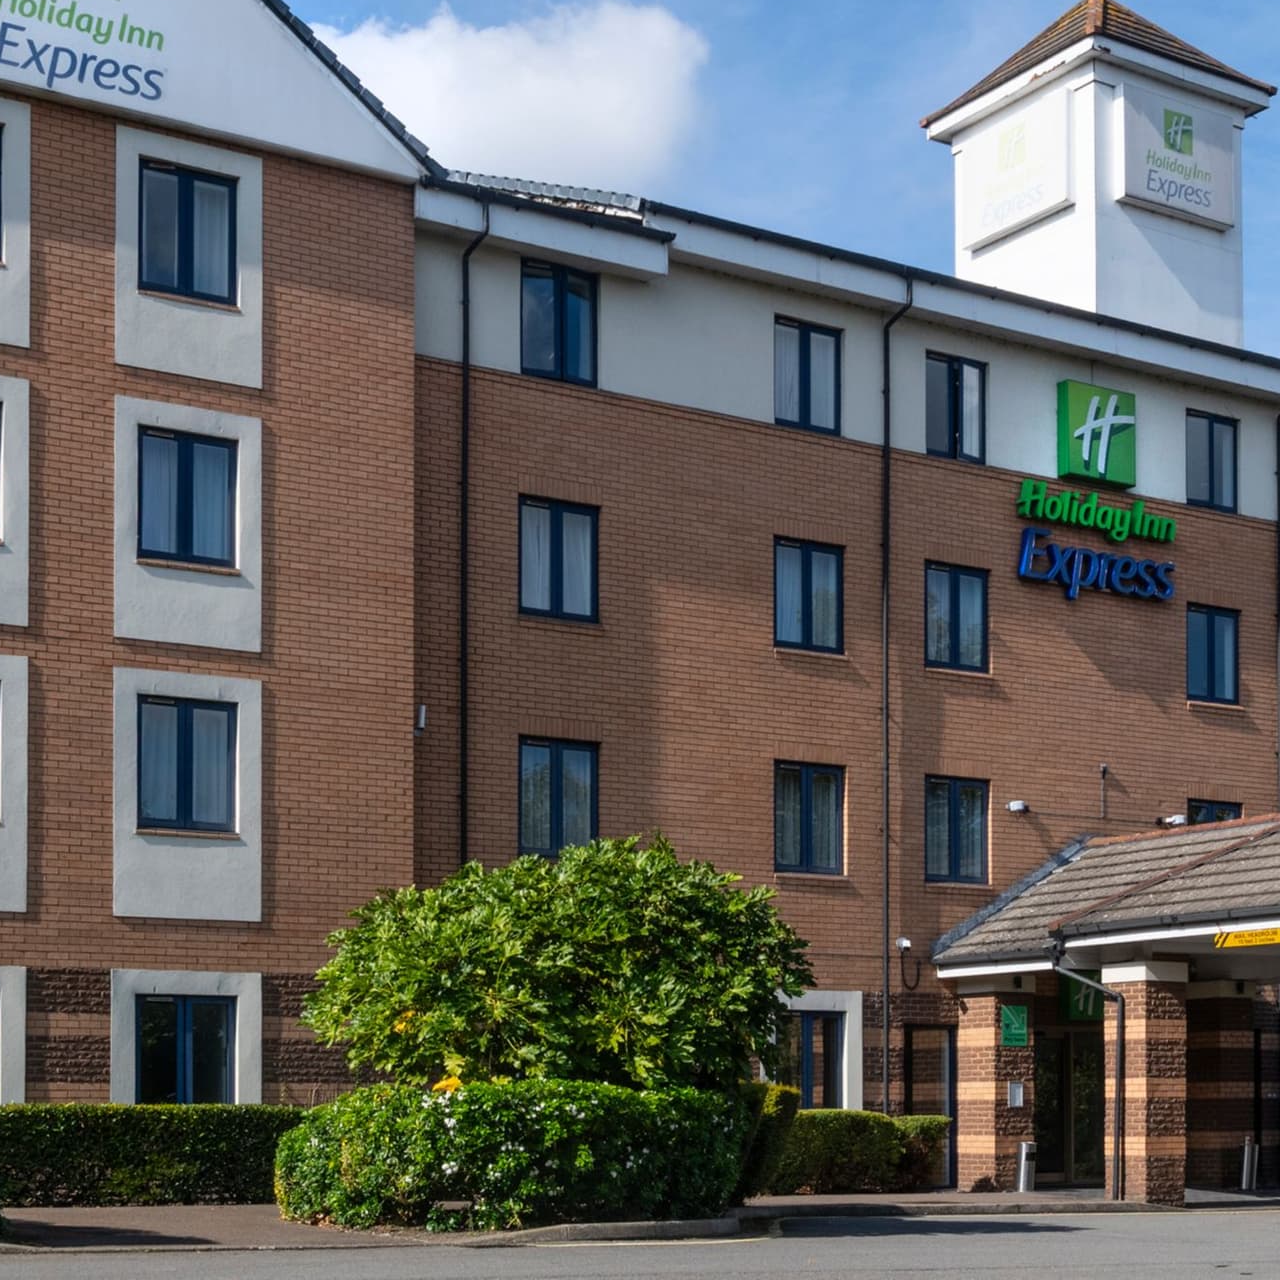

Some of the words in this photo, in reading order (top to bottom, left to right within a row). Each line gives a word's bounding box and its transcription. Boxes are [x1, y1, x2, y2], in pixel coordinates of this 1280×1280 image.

[118, 13, 165, 52] Inn
[1146, 148, 1193, 181] Holiday
[1194, 163, 1212, 183] Inn
[1146, 168, 1212, 208] Express
[1016, 478, 1131, 542] Holiday
[1132, 499, 1177, 543] Inn
[1016, 526, 1176, 601] Express
